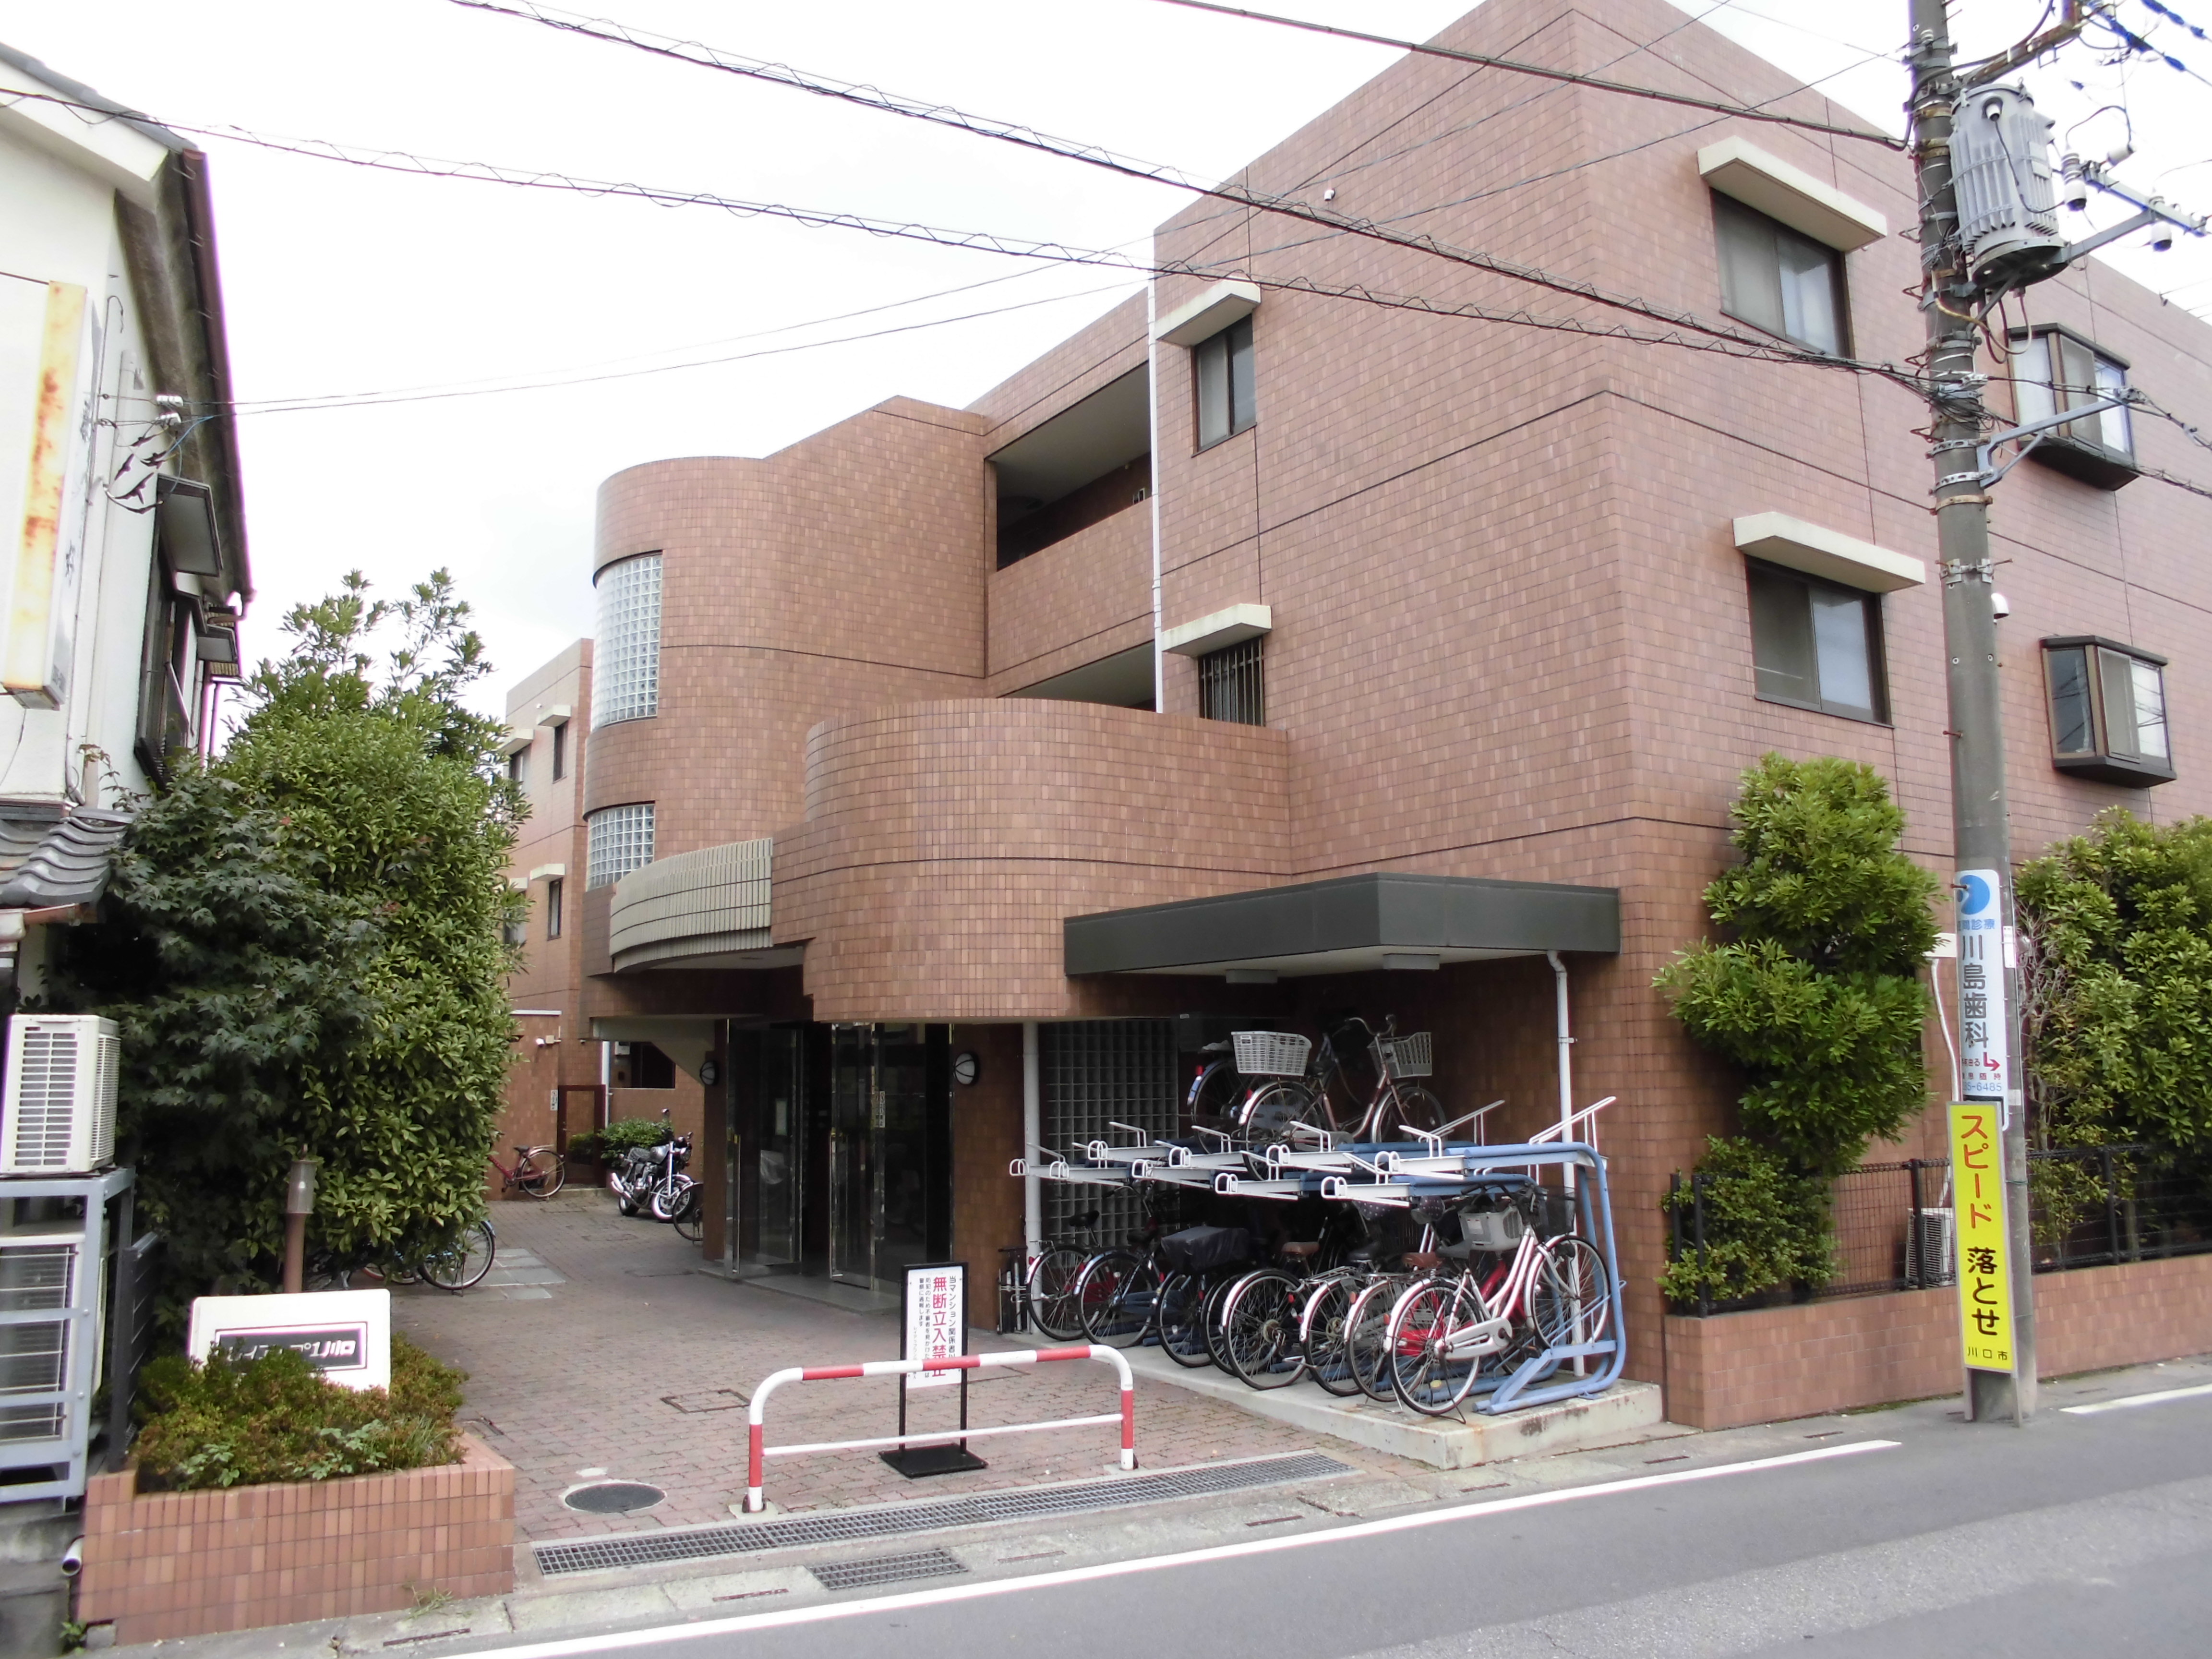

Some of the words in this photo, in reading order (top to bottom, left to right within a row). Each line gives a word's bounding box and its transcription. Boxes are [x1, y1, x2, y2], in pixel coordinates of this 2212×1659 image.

[1962, 934, 1989, 1048] 川島歯科
[1960, 1115, 1992, 1229] スピード
[1967, 1246, 2000, 1336] 落とせ
[1967, 1346, 2008, 1361] 川口市
